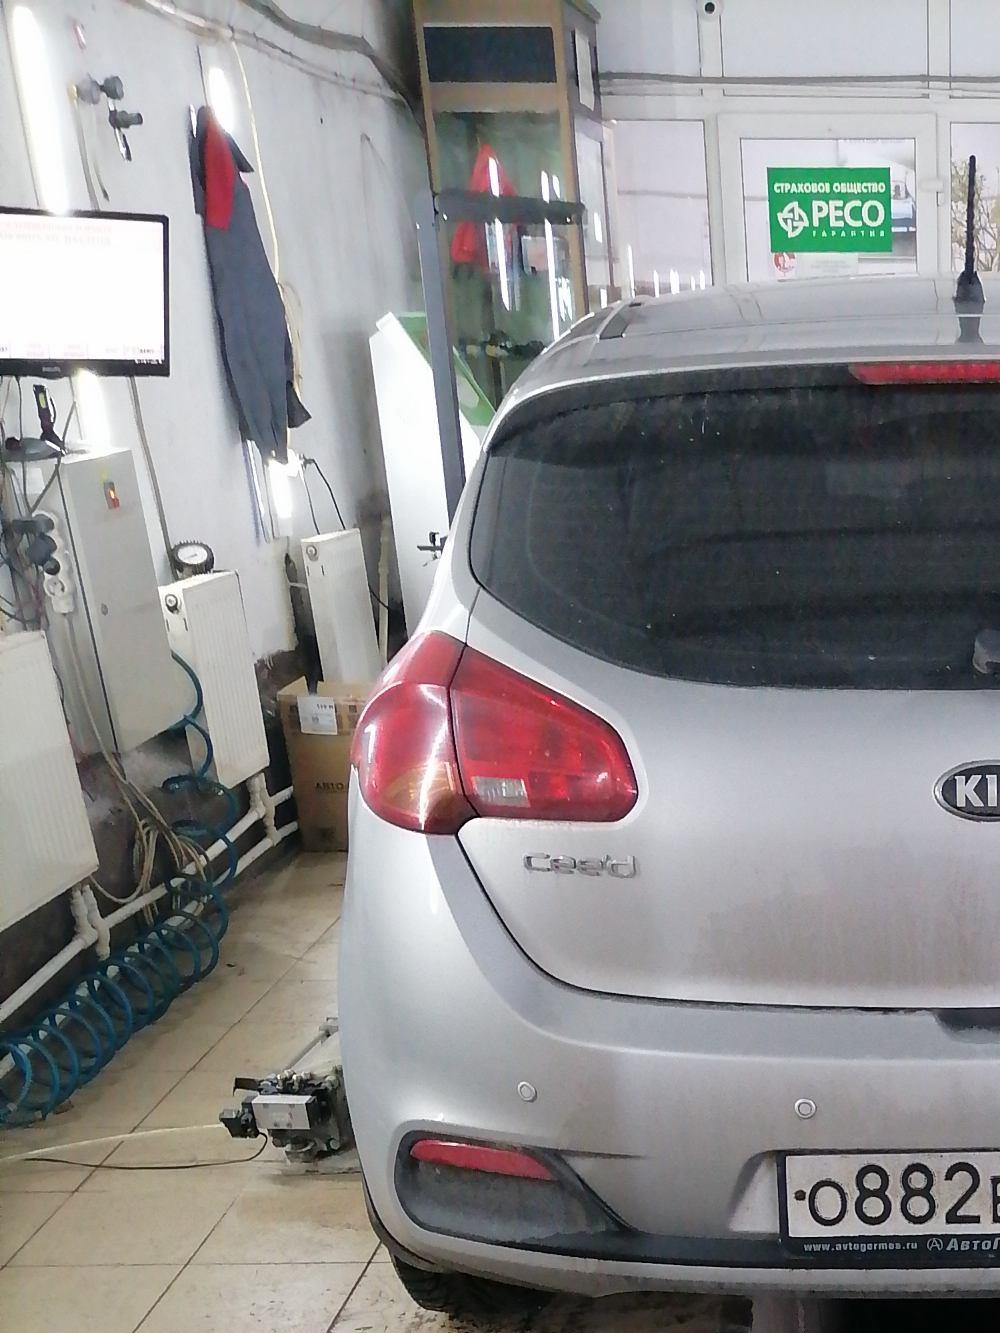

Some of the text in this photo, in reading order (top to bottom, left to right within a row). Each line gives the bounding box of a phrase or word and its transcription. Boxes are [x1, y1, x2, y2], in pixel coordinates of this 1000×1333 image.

[773, 182, 886, 195] СТРАХОВОЕ ОБЩЕСТВО
[811, 199, 886, 228] РЕСО
